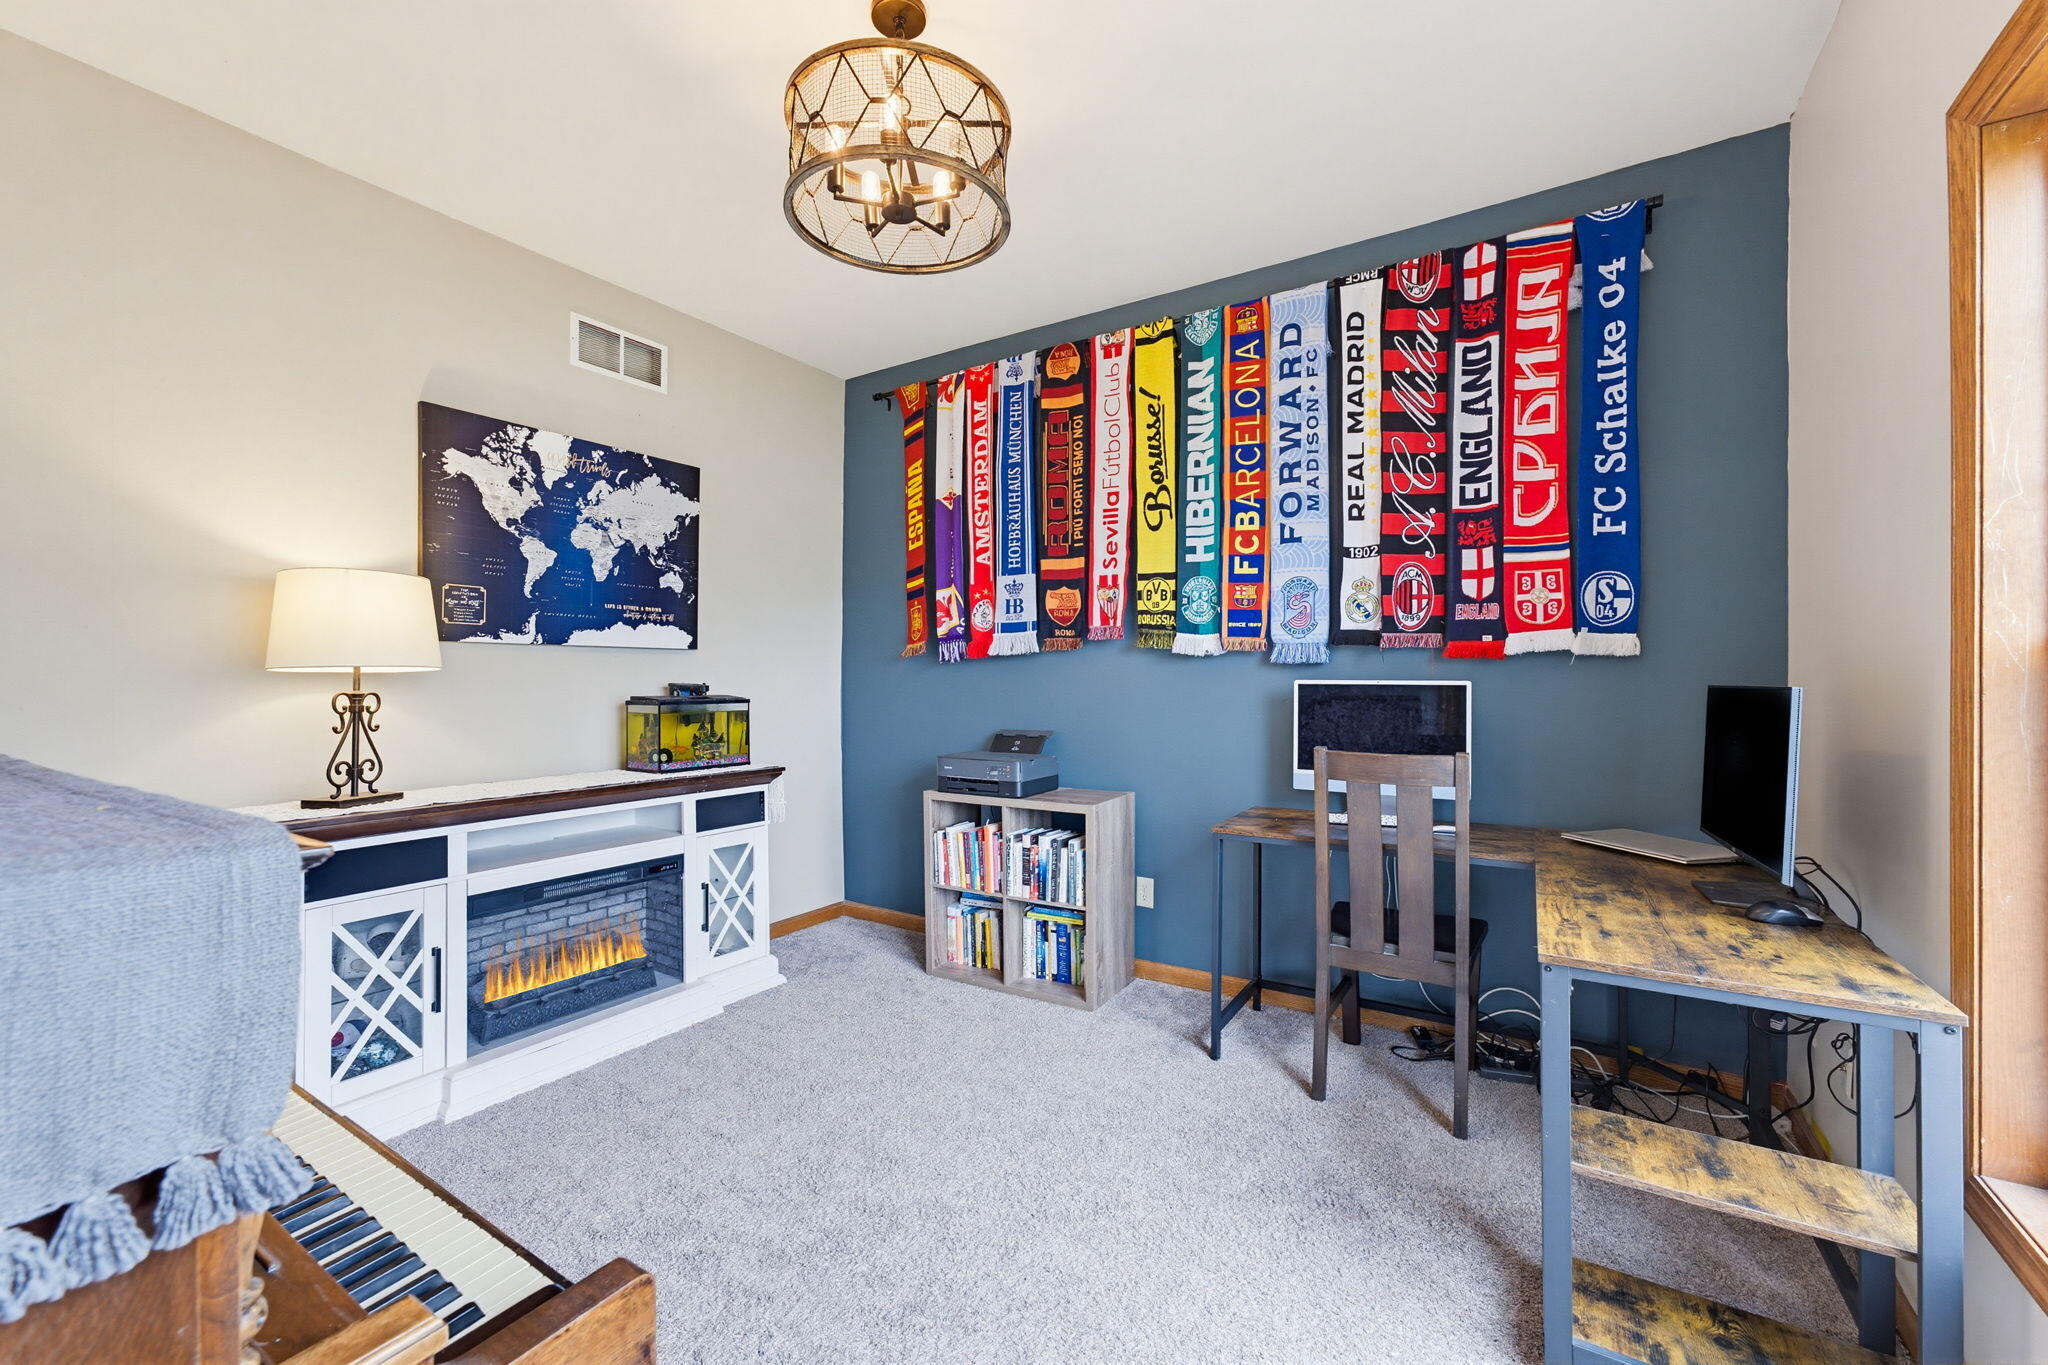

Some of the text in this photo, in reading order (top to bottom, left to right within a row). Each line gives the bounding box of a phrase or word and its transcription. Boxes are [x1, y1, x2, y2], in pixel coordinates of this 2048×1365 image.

[1347, 311, 1365, 521] REAL MADRID
[1392, 307, 1440, 448] Milan
[1459, 340, 1493, 506] ENGLAND
[1592, 255, 1627, 536] FC Schalke 04
[1073, 414, 1084, 439] NOI
[1073, 440, 1084, 476] SEMO
[1138, 386, 1173, 532] Borusse!
[1185, 356, 1215, 563] HIBERNIAN
[1279, 322, 1302, 544] FORWARD
[1307, 348, 1319, 511] MADISON FC
[905, 458, 923, 551] ESPAÑA
[973, 400, 991, 565] AMSTERDAM
[1007, 391, 1022, 569] HOFBRÄUHAUS MÜNCHEN
[1073, 478, 1084, 516] FORTI
[1146, 581, 1168, 601] BVB
[1349, 545, 1379, 558] 1902
[1401, 569, 1423, 581] ACM
[1005, 598, 1024, 615] HB
[1138, 614, 1176, 626] BORUSSIA
[1455, 603, 1500, 620] ENGLAND
[1596, 604, 1614, 618] 04
